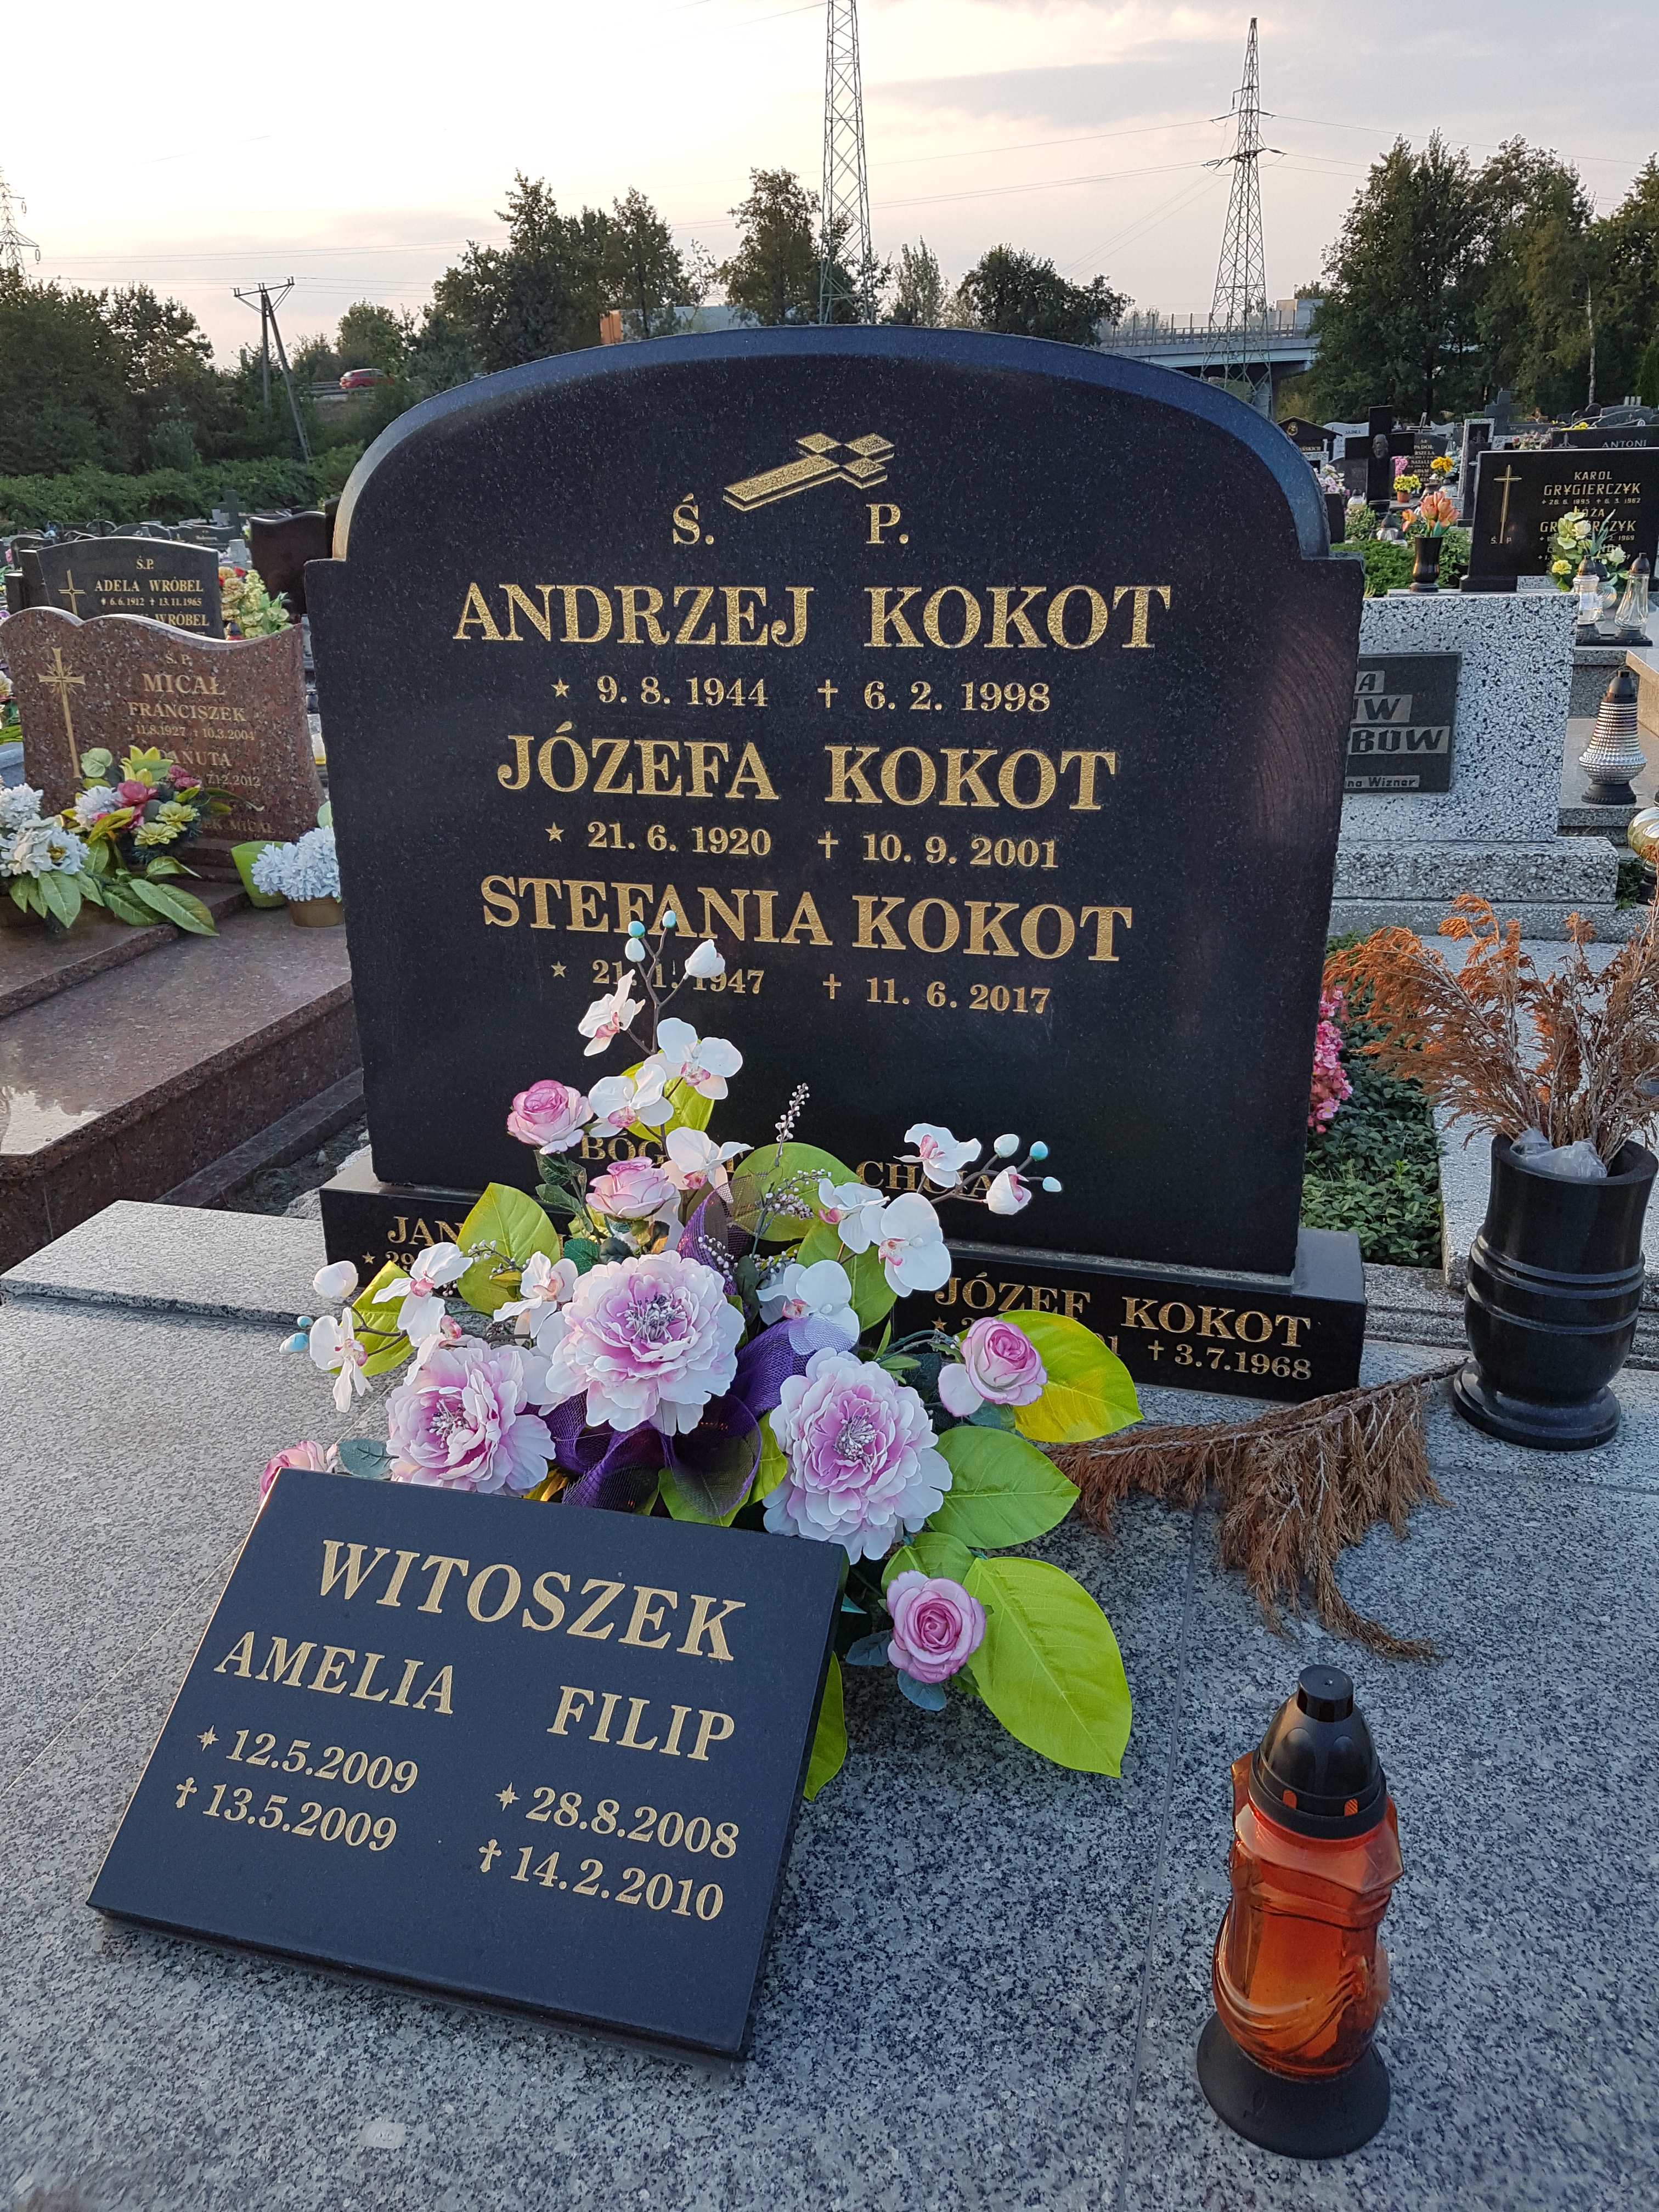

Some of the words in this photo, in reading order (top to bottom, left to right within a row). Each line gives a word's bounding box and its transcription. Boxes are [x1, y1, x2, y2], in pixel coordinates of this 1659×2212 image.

[1574, 471, 1612, 481] KAROL
[1602, 439, 1647, 448] ANTONI
[673, 493, 715, 546] Ś.
[867, 504, 910, 545] P.
[1544, 483, 1641, 496] GRYGIERCZYK
[94, 579, 140, 592] ADELA
[149, 576, 204, 592] WRÓBEL
[454, 582, 815, 648] ANDRZEJ
[865, 585, 1172, 651] KOKOT
[155, 611, 210, 627] WRÓBEL
[127, 702, 247, 721] FRANCISZEK
[142, 673, 227, 696] MICAŁ
[497, 721, 780, 801] JÓZEFA
[825, 746, 1116, 811] KOKOT
[481, 875, 834, 947] STEFANIA
[852, 895, 1133, 963] KOKOT
[934, 1271, 1091, 1321] JÓZEF
[1121, 1296, 1312, 1348] KOKOT
[1175, 1344, 1312, 1381] 3.7.1968
[320, 1539, 746, 1662] WITOSZEK
[213, 1630, 454, 1715] AMELIA
[548, 1686, 735, 1762] FILIP
[225, 1729, 419, 1795] 12.5.2009
[202, 1784, 398, 1852] 13.5.2009
[526, 1786, 740, 1859] 28.8.2008
[510, 1846, 724, 1921] 14.2.2010
